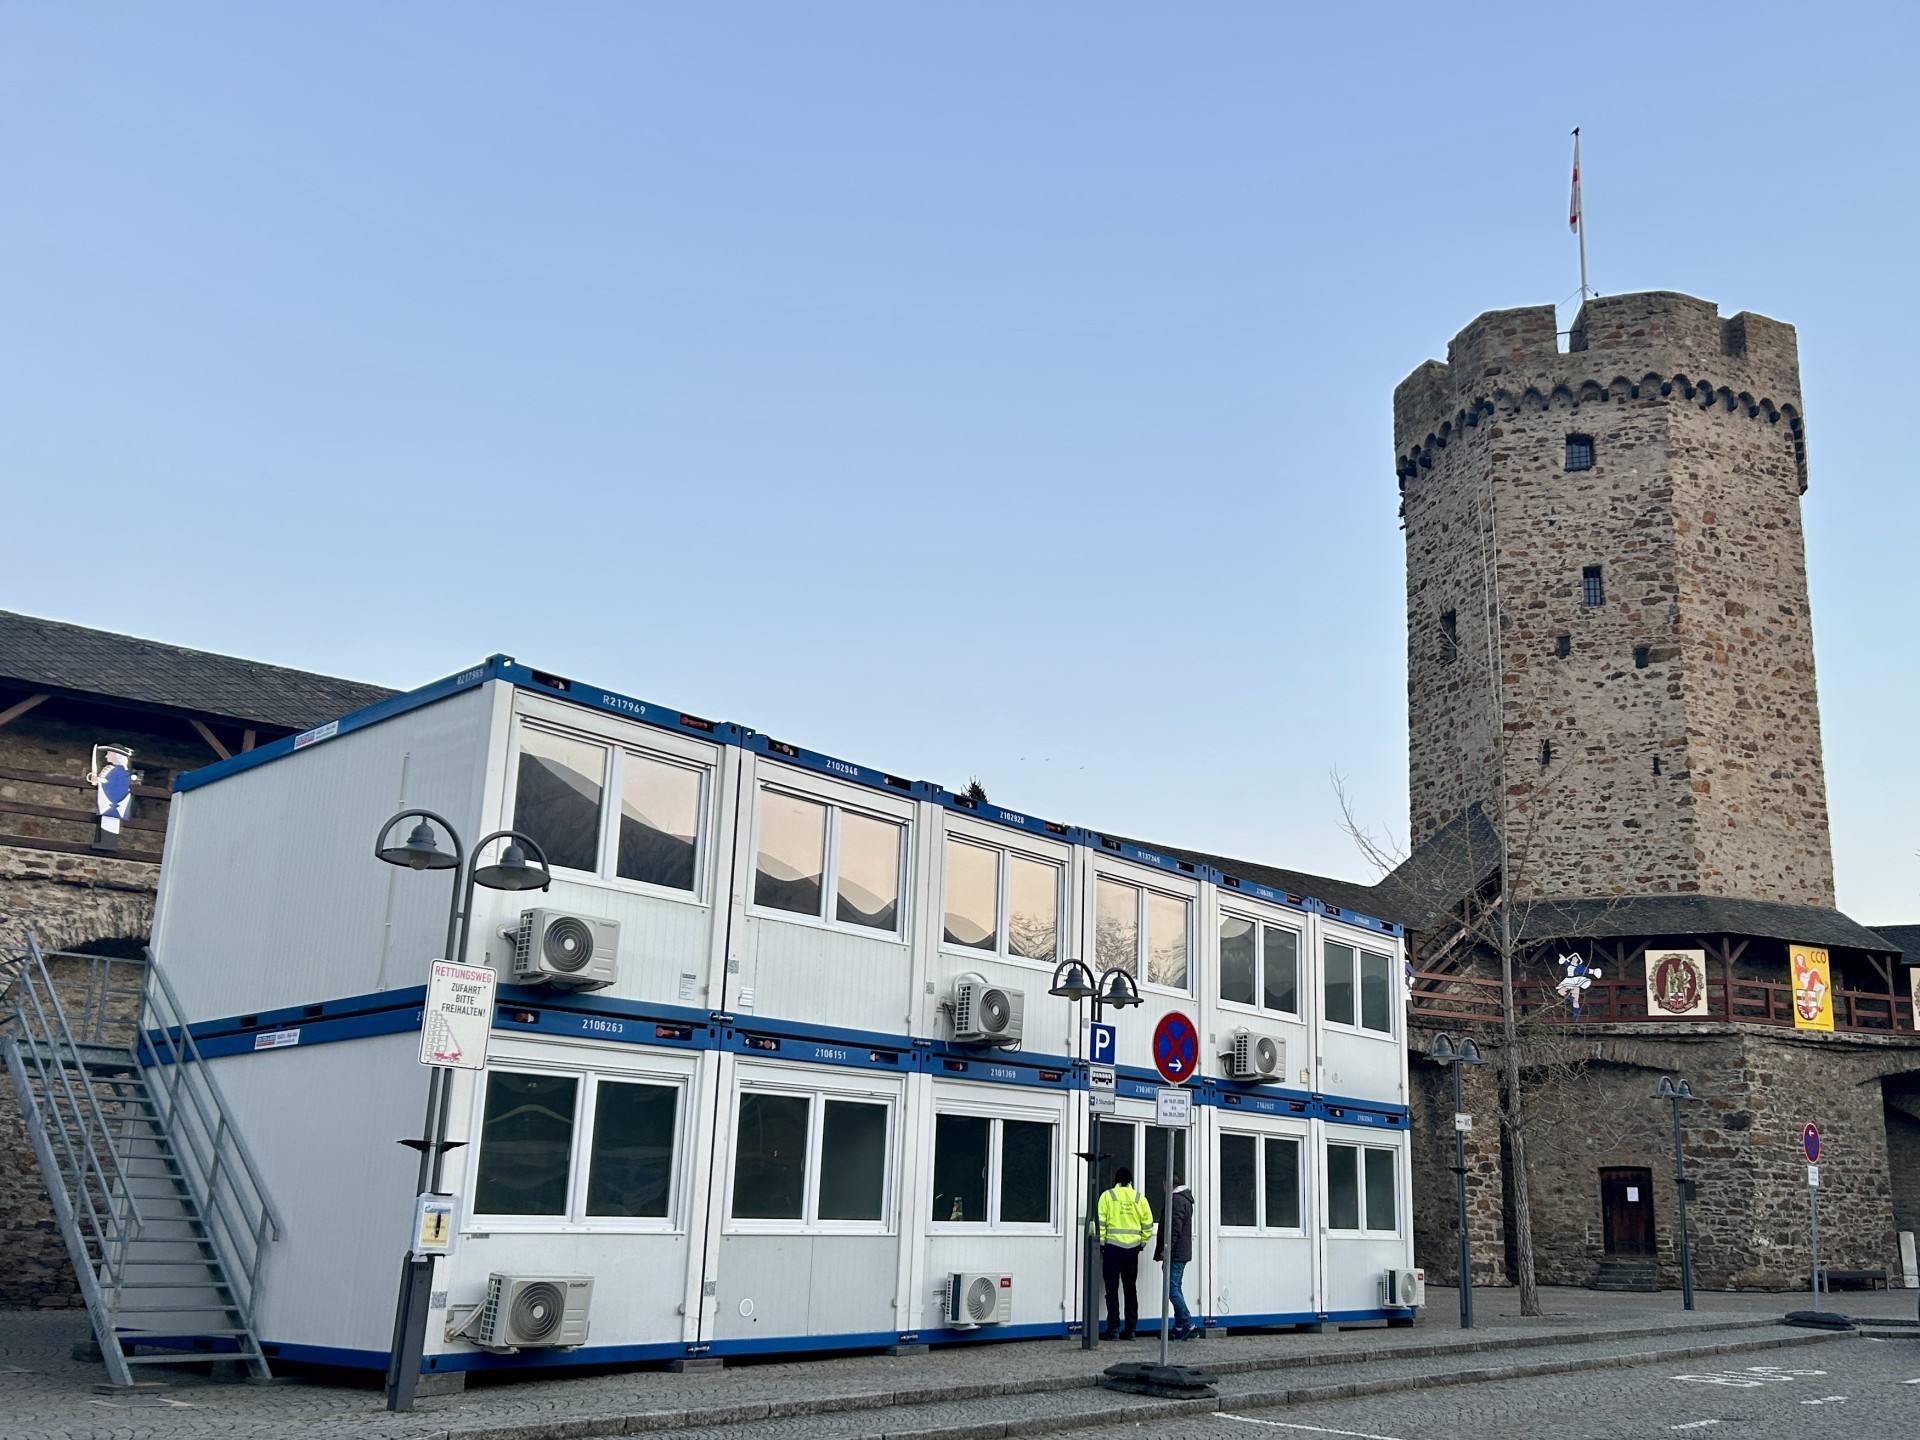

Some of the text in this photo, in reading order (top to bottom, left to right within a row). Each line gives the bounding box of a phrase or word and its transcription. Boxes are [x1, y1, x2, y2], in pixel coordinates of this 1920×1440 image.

[602, 694, 646, 715] R217969
[826, 760, 858, 776] 2102946
[1810, 951, 1827, 964] CCO
[435, 966, 492, 983] RETTUNGSWEG
[451, 983, 482, 995] ZUFAHRT
[455, 994, 475, 1005] BITTE
[441, 1003, 486, 1017] FREIHALTEN!
[582, 1019, 623, 1034] 2106263
[1095, 1028, 1110, 1059] P
[815, 1047, 847, 1060] 2106151
